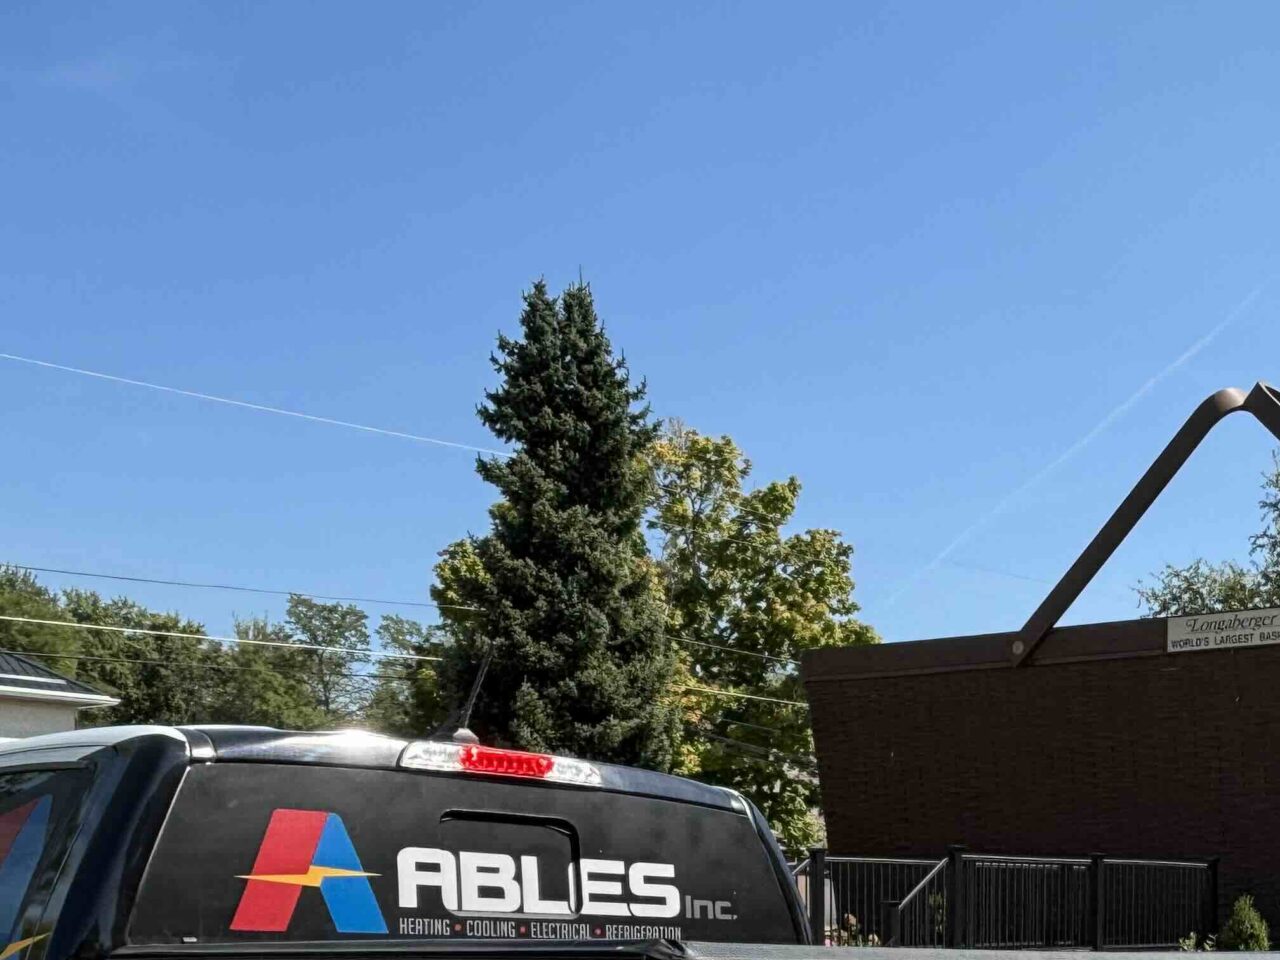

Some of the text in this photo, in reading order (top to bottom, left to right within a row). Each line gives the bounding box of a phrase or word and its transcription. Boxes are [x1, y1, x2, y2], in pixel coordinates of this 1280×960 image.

[1185, 613, 1280, 634] Longaberger
[1171, 636, 1209, 649] WORLD'S
[1215, 632, 1254, 646] LARGEST
[397, 846, 681, 919] ABLES
[399, 918, 682, 940] HEATING COOLING ELECTRICAL REFRIGERATION
